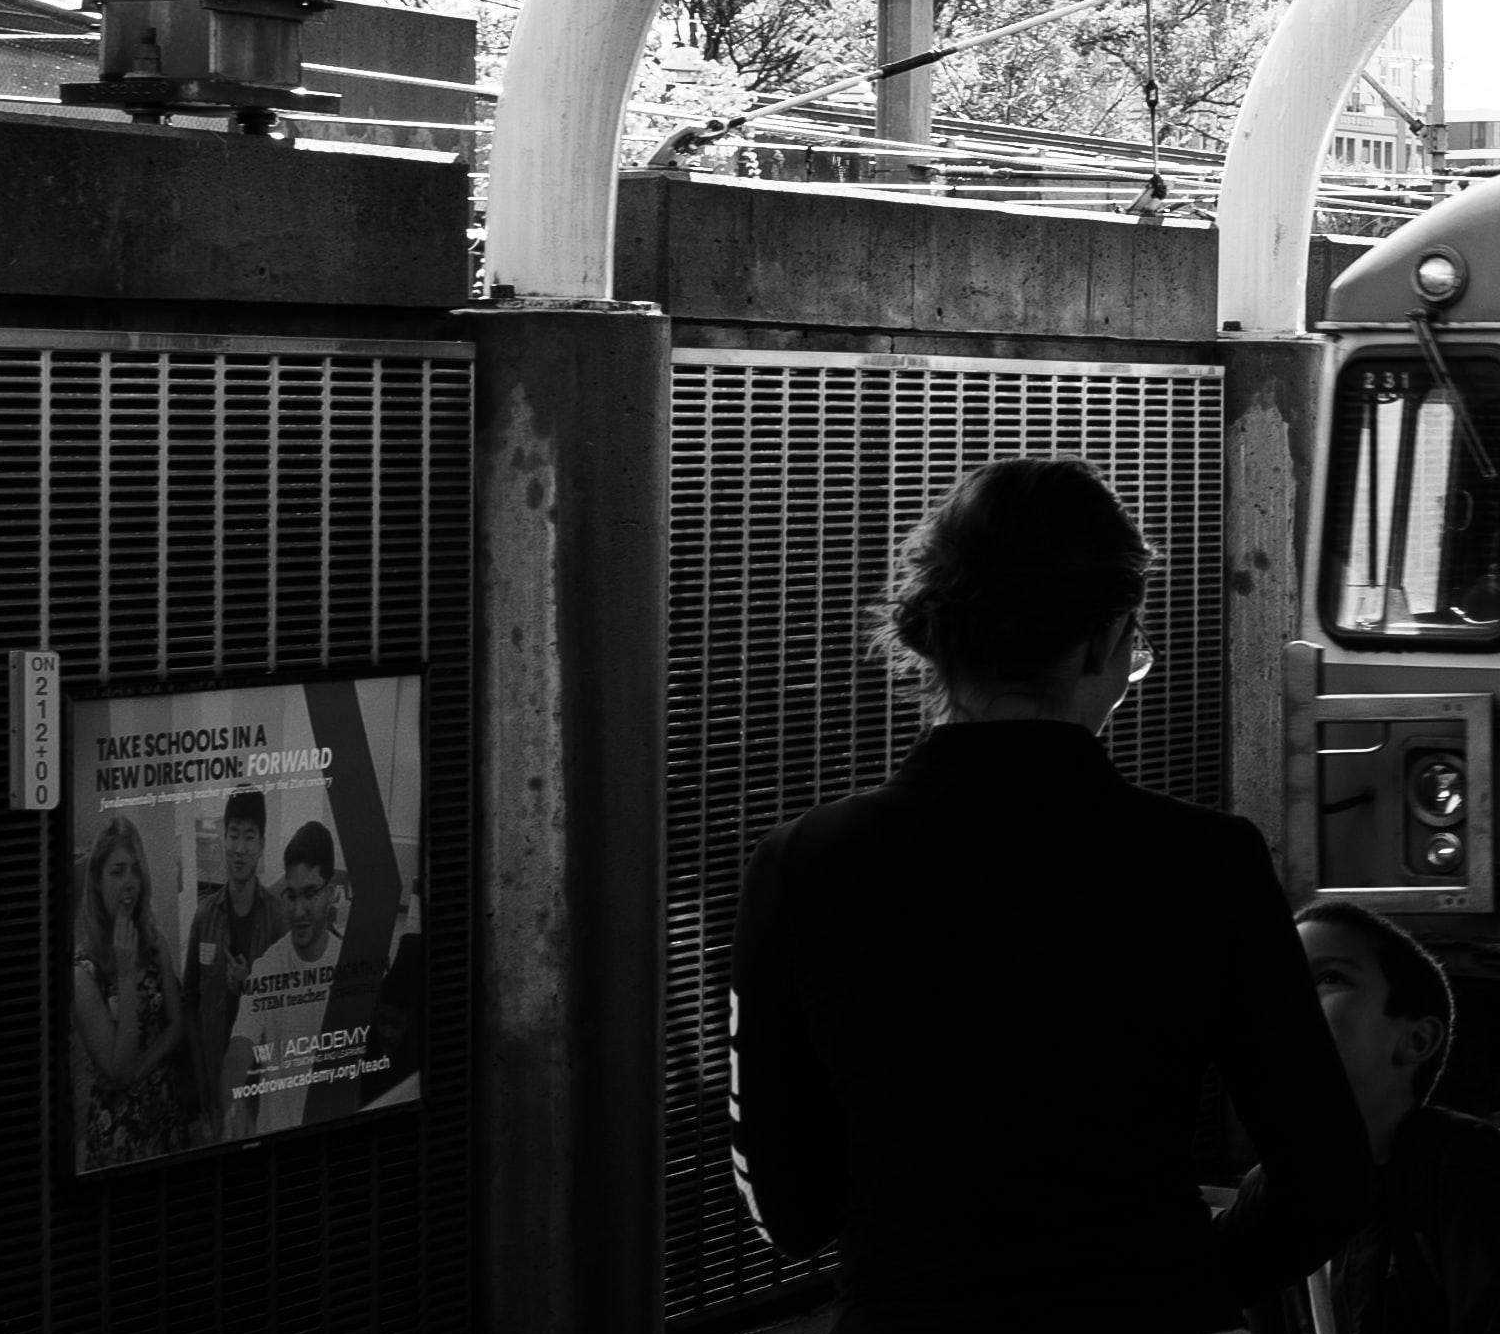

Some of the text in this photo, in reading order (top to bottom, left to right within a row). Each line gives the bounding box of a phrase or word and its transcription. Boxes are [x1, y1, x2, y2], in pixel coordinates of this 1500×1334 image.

[31, 657, 55, 671] ON
[96, 724, 267, 761] TAKE SCHOOLS IN A
[96, 747, 333, 792] NEW DIRECTION: FORWARD
[252, 993, 284, 1013] STEM
[286, 988, 327, 1007] teacher
[283, 1024, 371, 1058] ACADEMY
[231, 1054, 392, 1099] woodrowacademy.org/teach
